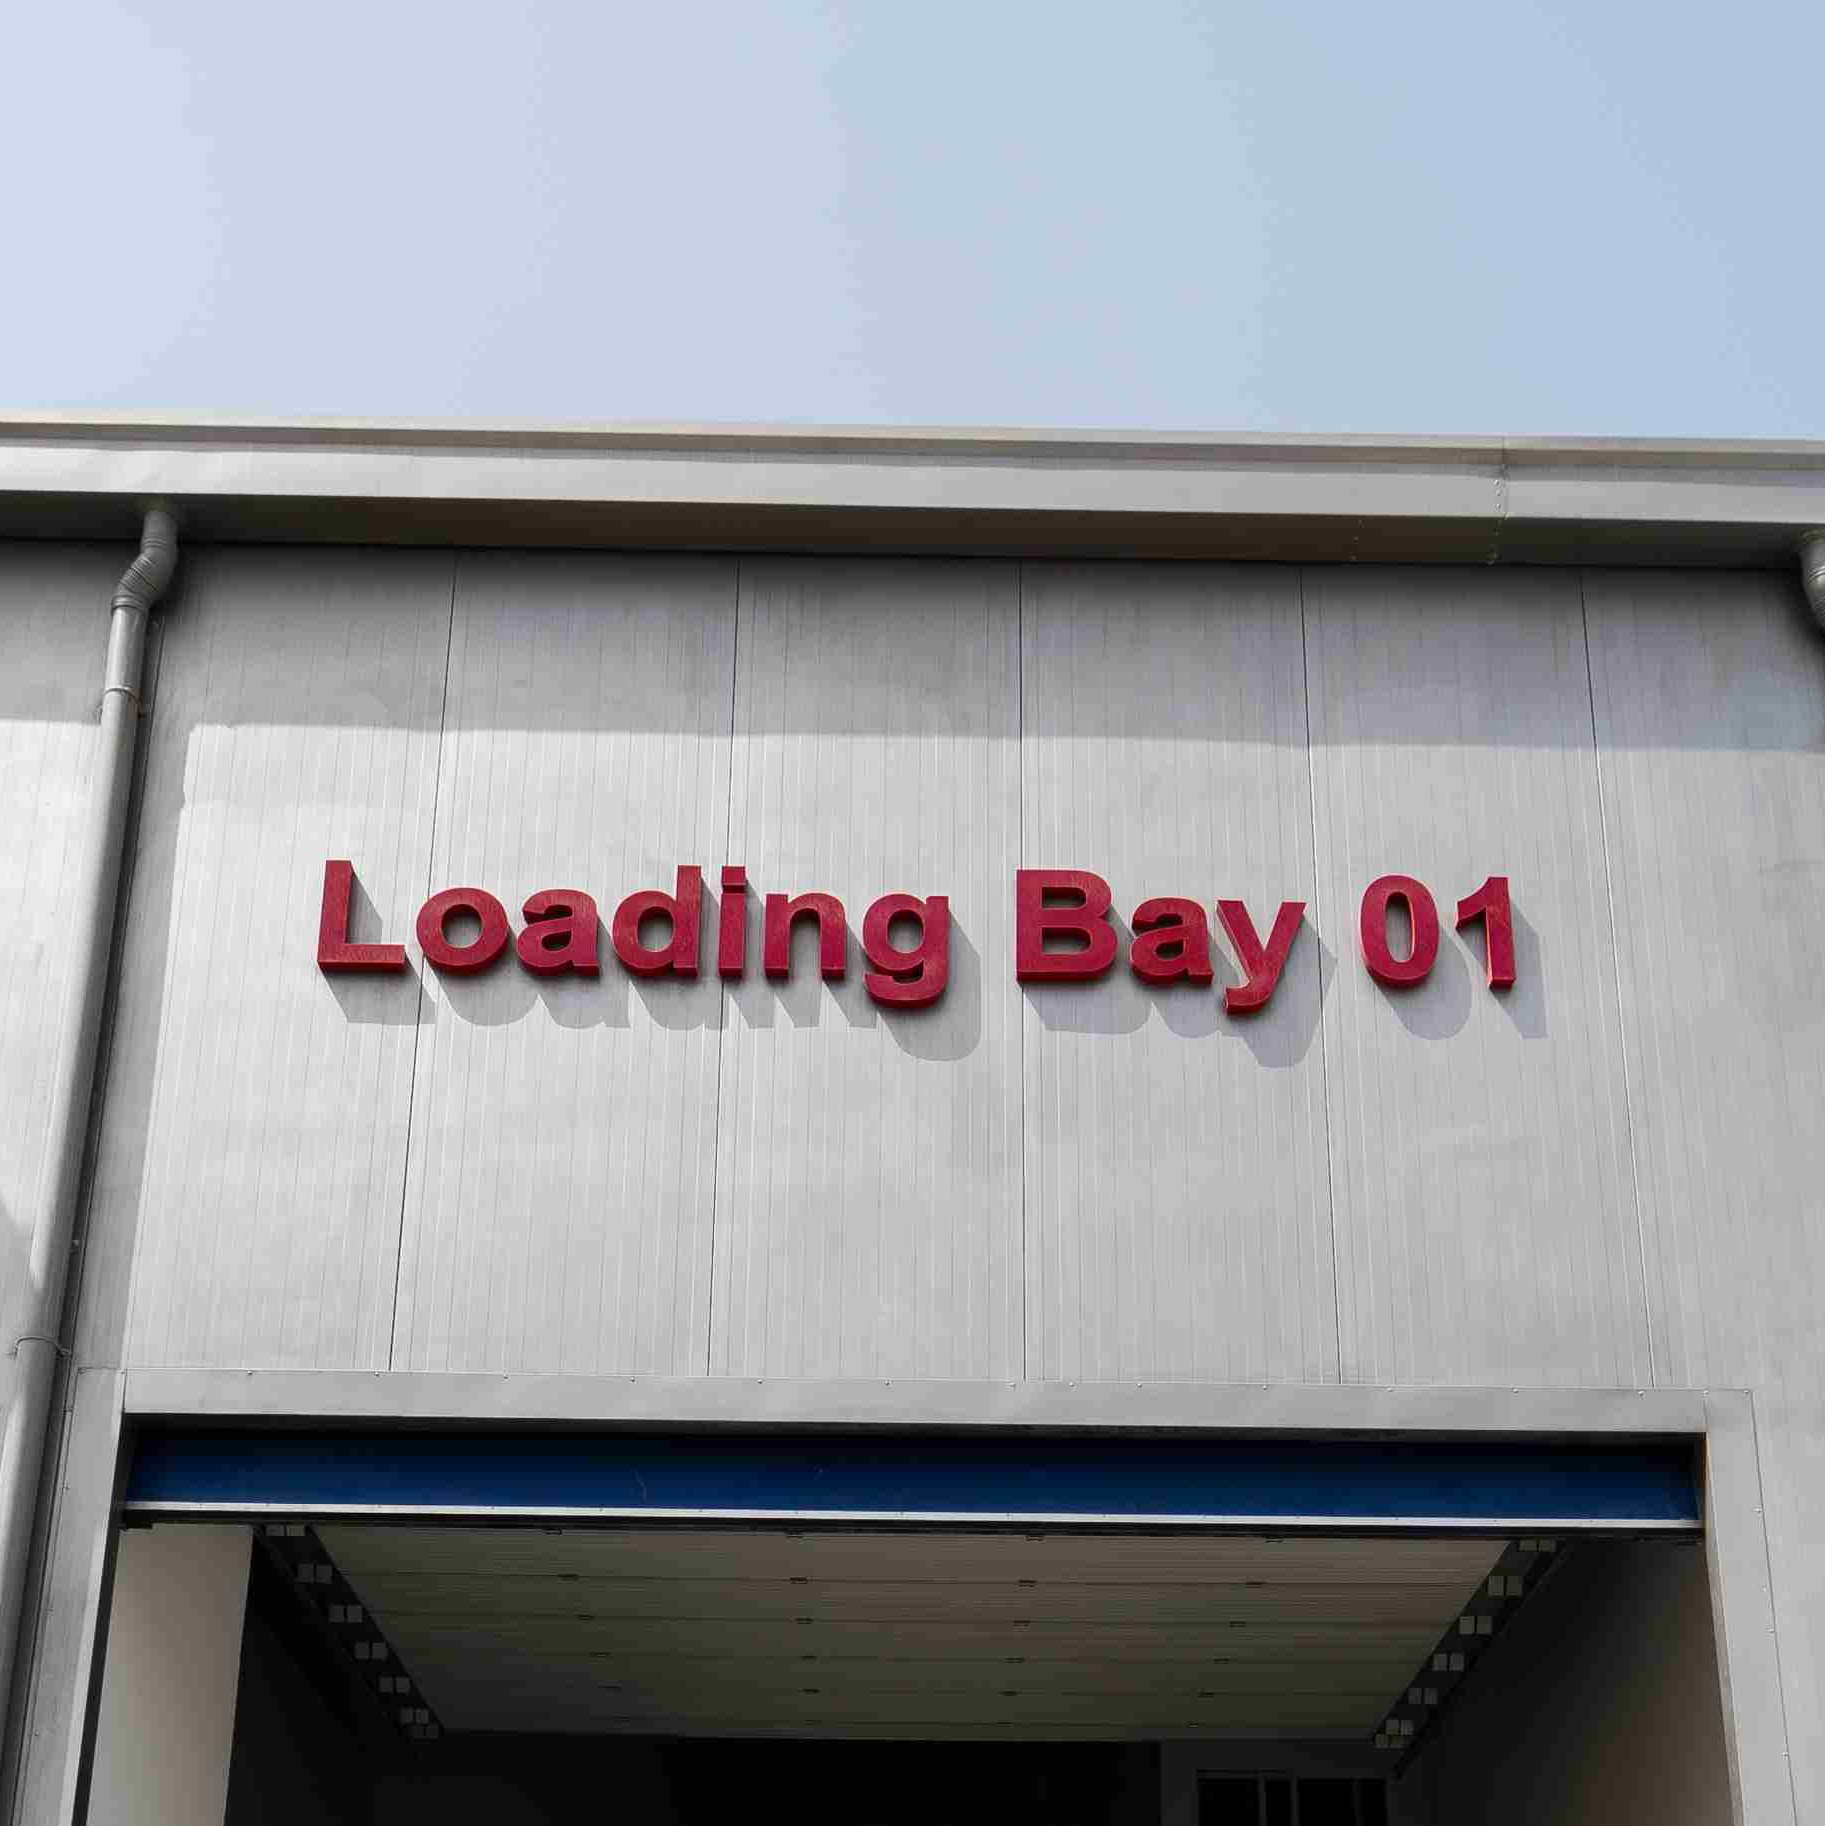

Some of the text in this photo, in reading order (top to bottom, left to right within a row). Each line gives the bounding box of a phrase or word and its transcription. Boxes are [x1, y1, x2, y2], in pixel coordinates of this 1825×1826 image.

[317, 860, 1517, 1016] Loading Bay 01
